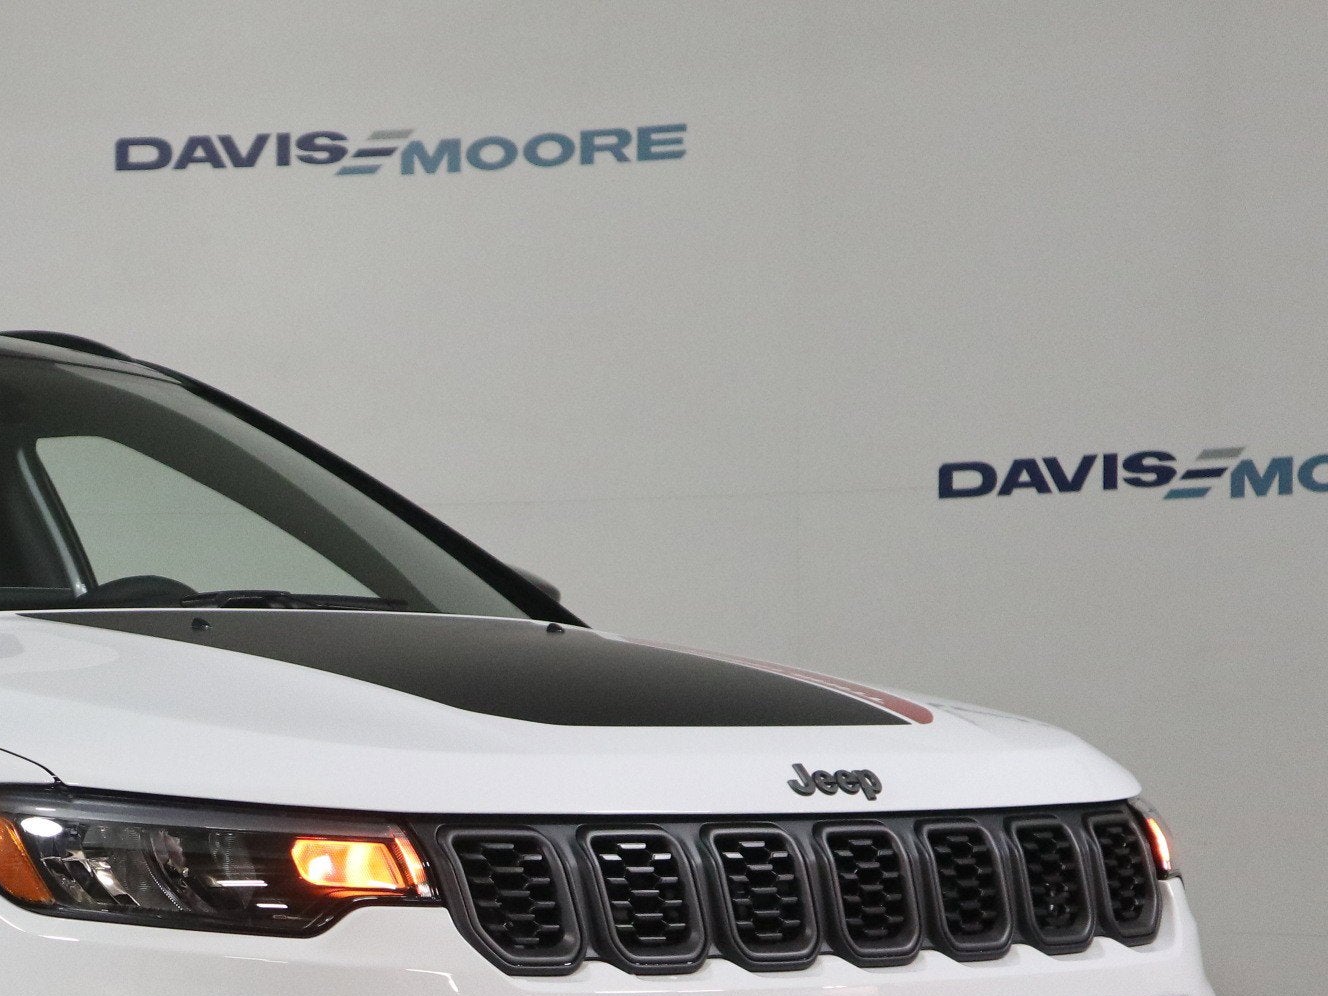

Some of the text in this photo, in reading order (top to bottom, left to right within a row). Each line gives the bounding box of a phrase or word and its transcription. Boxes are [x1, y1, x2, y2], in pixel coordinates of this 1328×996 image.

[114, 124, 688, 175] DAVIS MOORE
[938, 450, 1177, 499] DAVIS
[787, 763, 883, 801] Jeep
